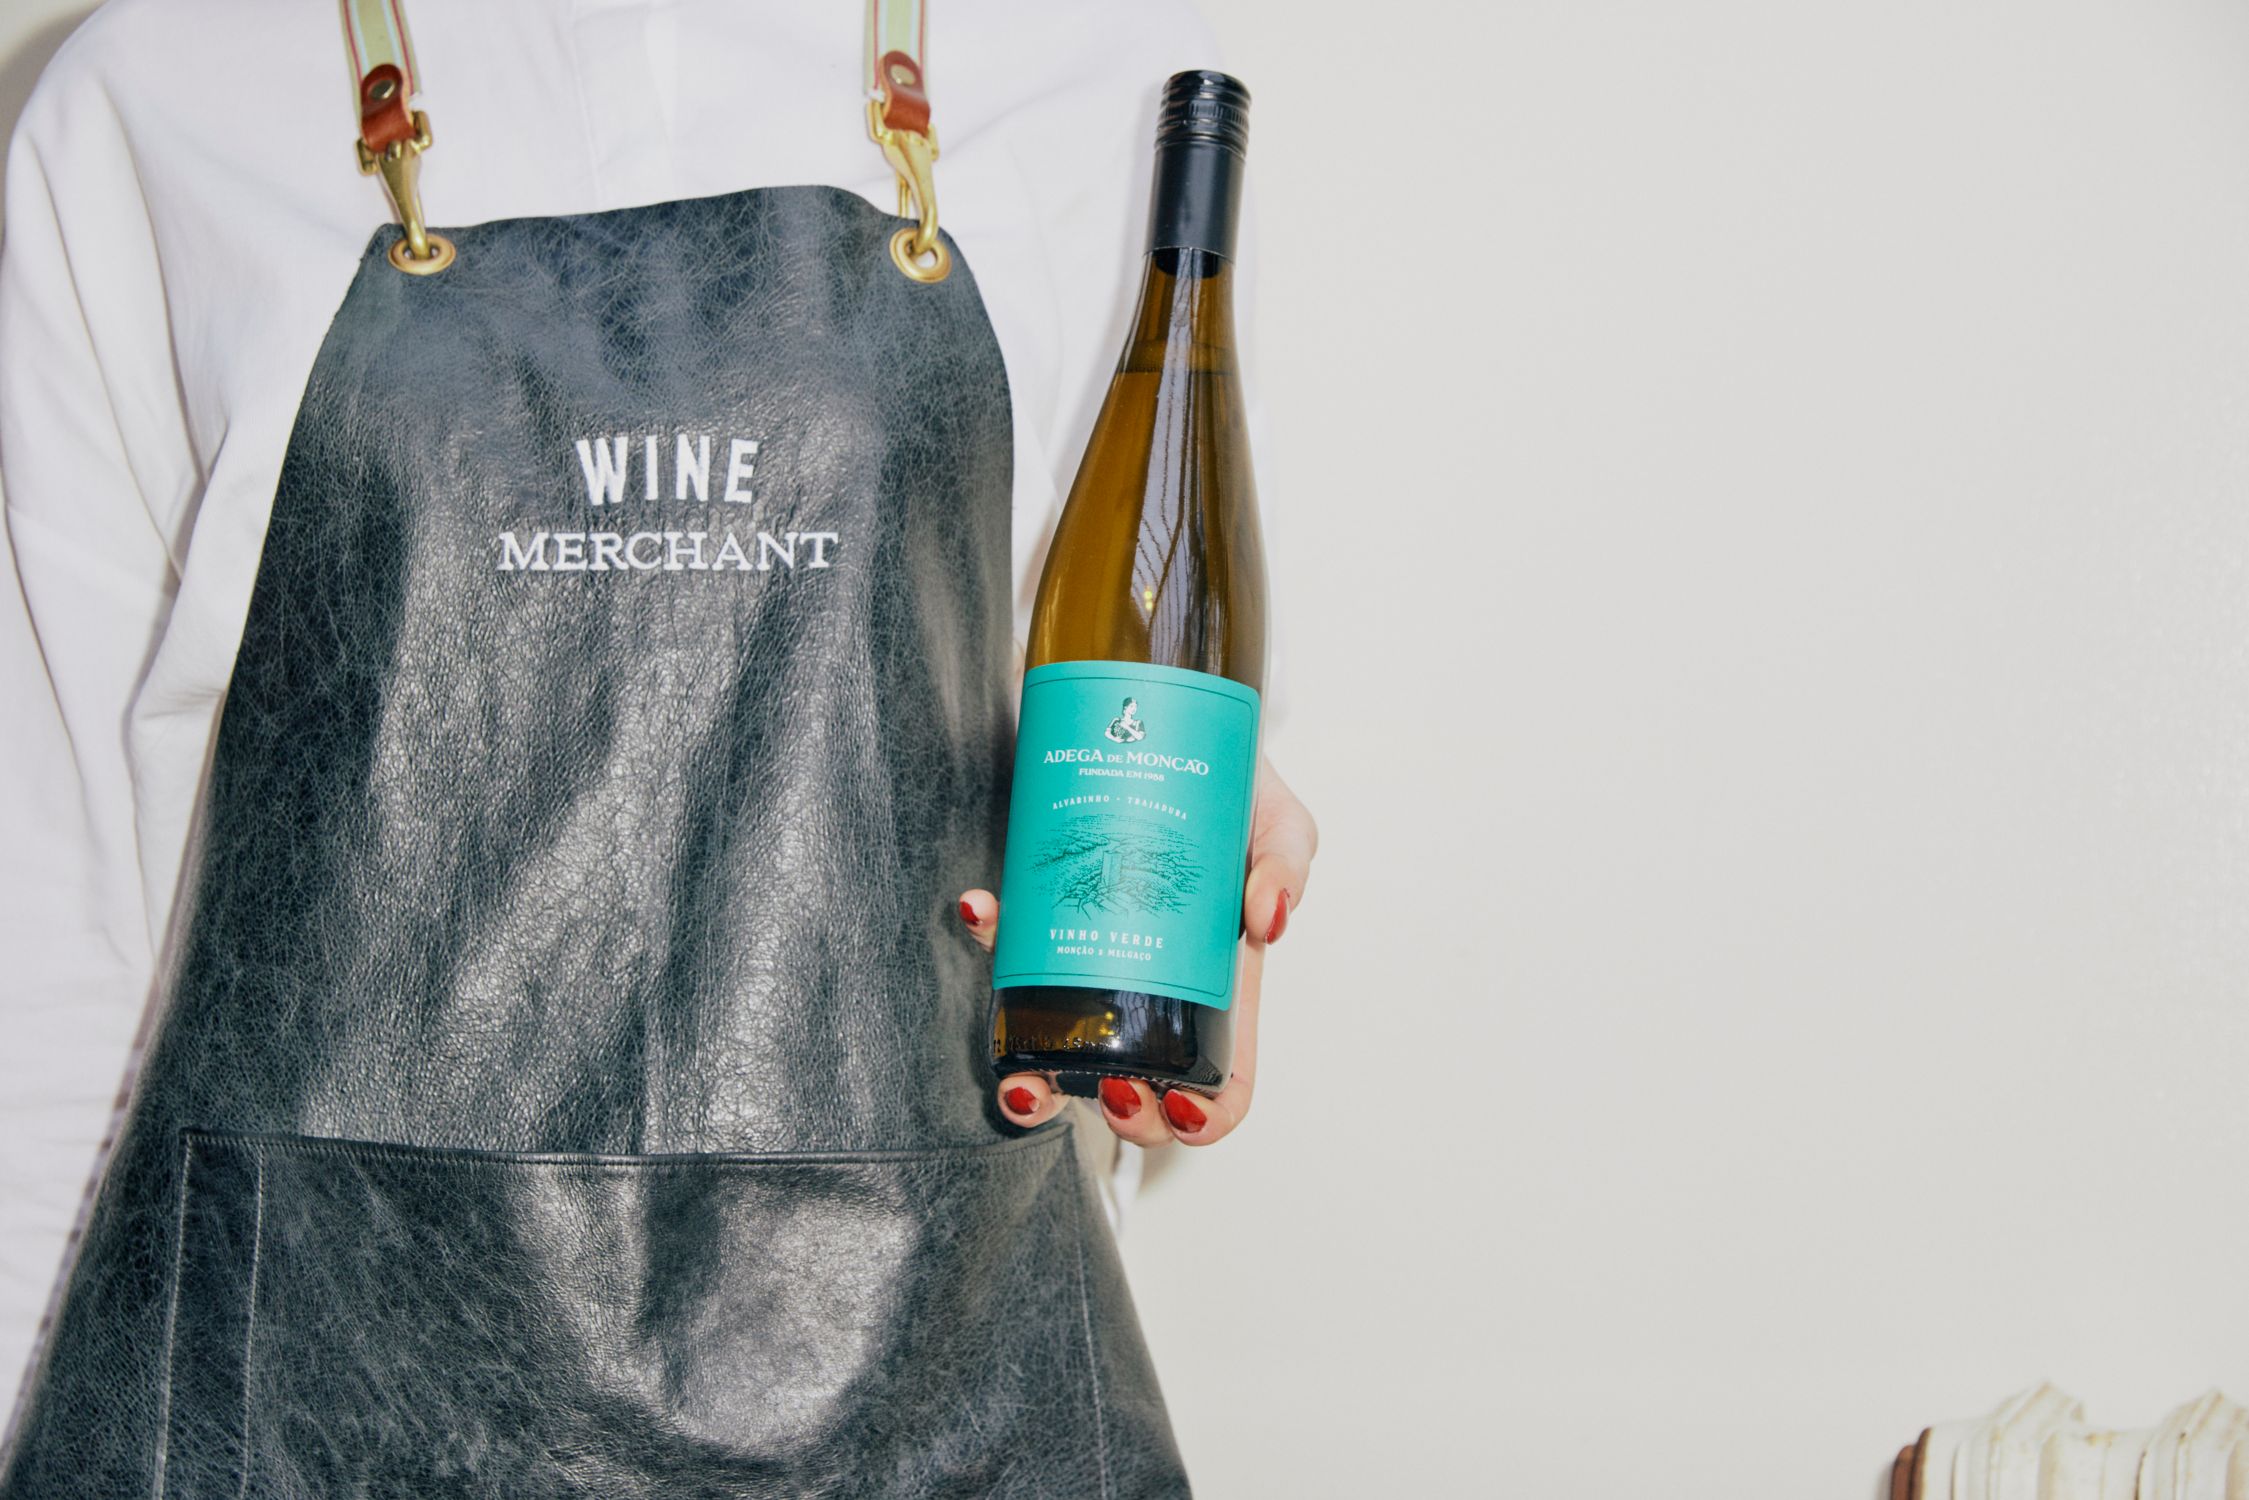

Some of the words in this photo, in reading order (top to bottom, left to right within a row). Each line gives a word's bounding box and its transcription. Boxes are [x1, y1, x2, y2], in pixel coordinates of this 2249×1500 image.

[575, 433, 759, 506] WINE
[497, 531, 839, 571] MERCHANT
[1043, 748, 1104, 764] ADEGA
[1107, 754, 1123, 764] DE
[1079, 768, 1124, 777] FUNDADA
[1126, 771, 1142, 779] EM
[1052, 794, 1110, 810] ALVARINHO
[1127, 796, 1187, 820] TRAJADURA
[1050, 929, 1098, 940] VINHO
[1110, 932, 1163, 948] VERDE
[1108, 949, 1152, 961] MELGAÇO
